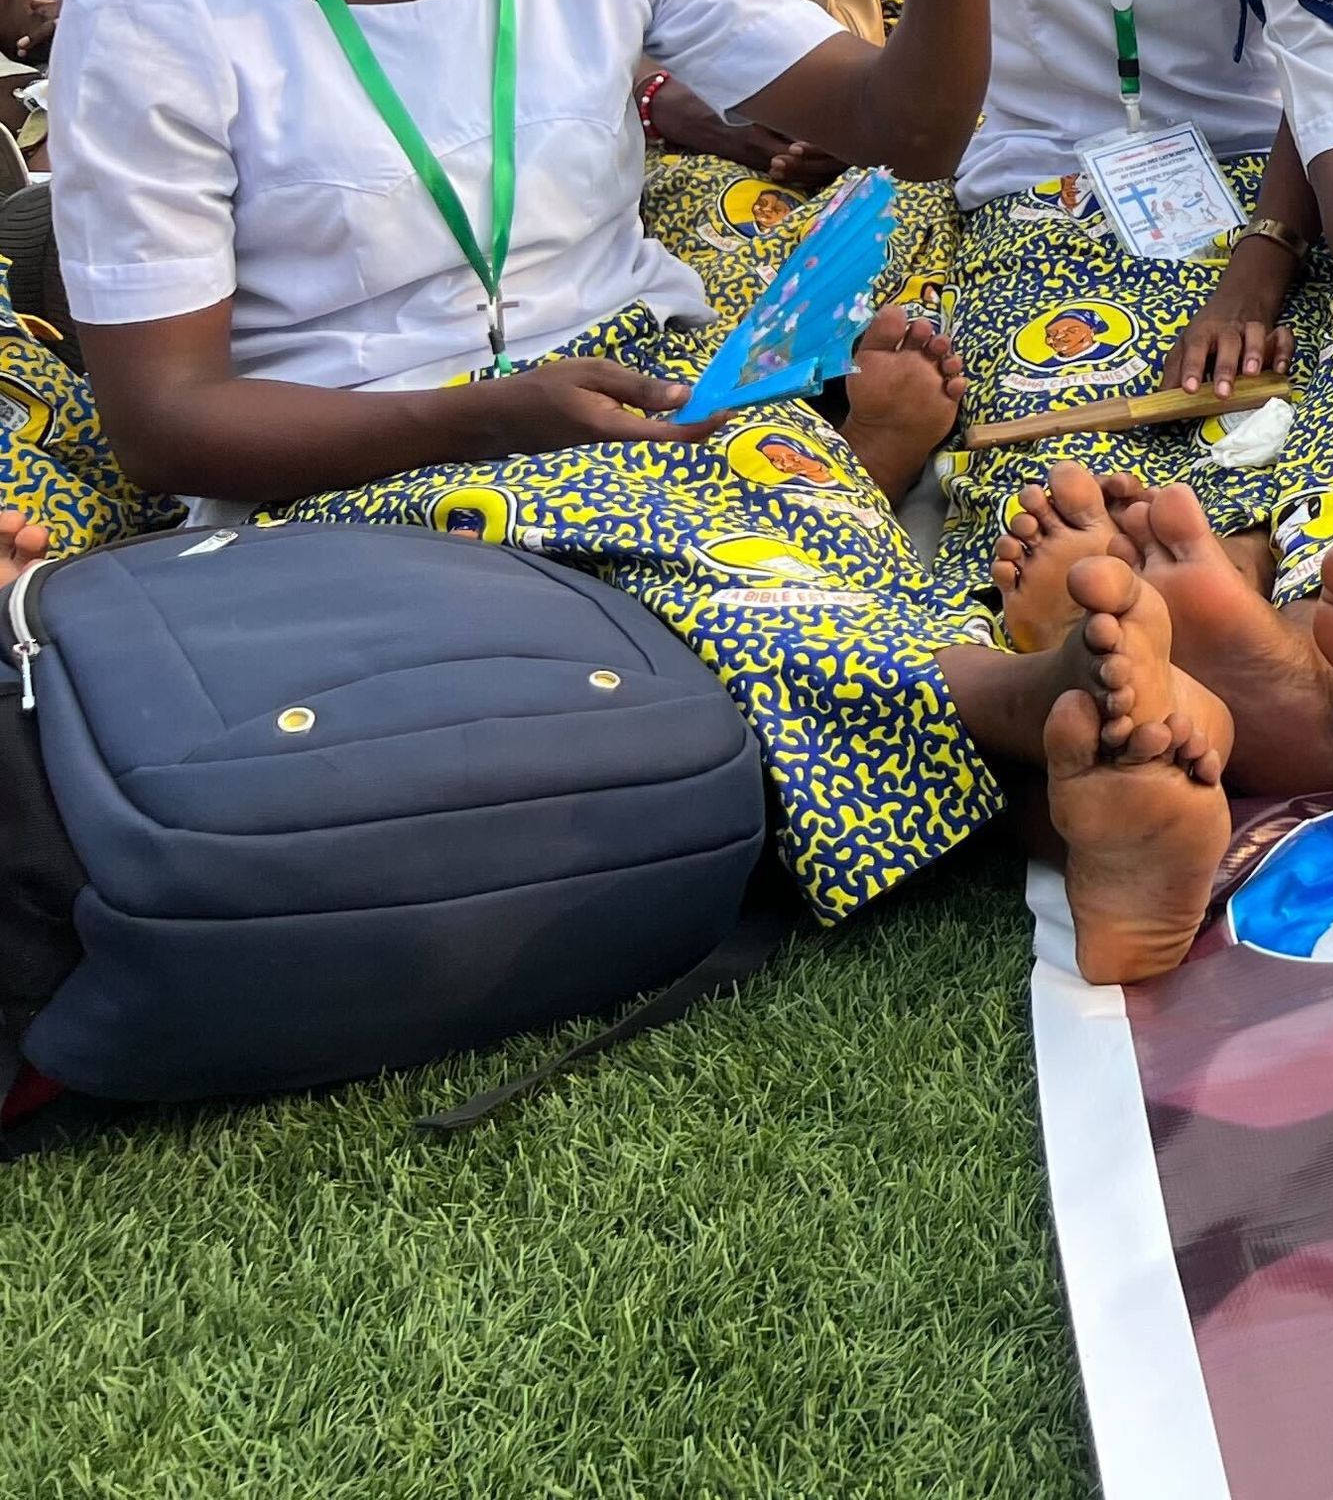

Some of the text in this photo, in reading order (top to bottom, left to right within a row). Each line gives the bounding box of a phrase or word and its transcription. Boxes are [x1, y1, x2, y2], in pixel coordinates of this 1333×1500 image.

[1009, 358, 1142, 389] MAMA CATECHISTE
[743, 590, 792, 603] BIBLE
